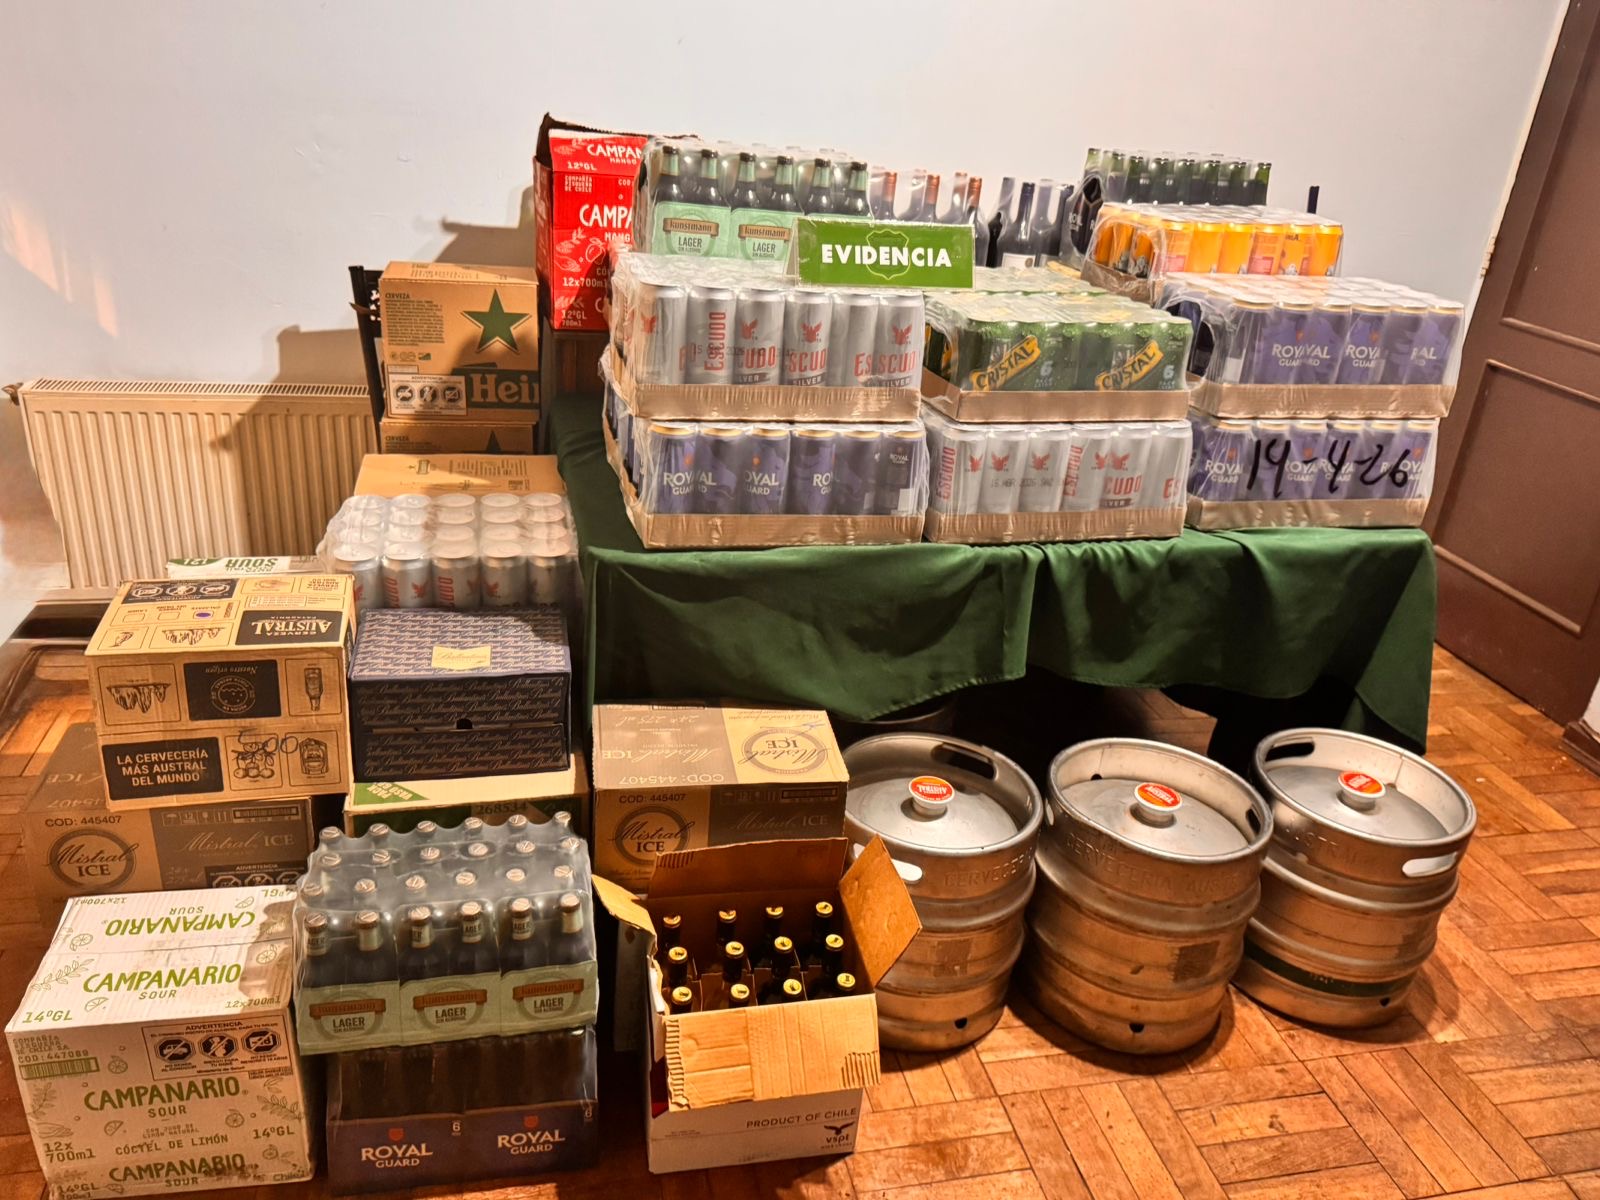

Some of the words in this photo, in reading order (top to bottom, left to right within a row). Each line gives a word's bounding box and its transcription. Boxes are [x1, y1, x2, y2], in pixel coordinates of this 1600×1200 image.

[678, 236, 703, 248] LAGER
[752, 242, 777, 254] LAGER
[821, 244, 953, 269] EVIDENCIA
[975, 344, 1035, 390] CRISTAL
[1040, 361, 1053, 376] 6
[1101, 351, 1156, 390] CRISTAL
[1163, 364, 1175, 380] 6
[225, 557, 279, 568] SOUR
[250, 618, 332, 636] AUSTRAL
[765, 739, 798, 748] ICE
[116, 755, 133, 766] LA
[135, 749, 209, 765] CERVECERÍA
[602, 750, 632, 760] ICE
[737, 748, 828, 765] Mistral
[122, 763, 149, 777] MÁS
[151, 760, 207, 774] AUSTRAL
[131, 775, 155, 787] DEL
[156, 773, 200, 786] MUNDO
[619, 774, 678, 786] 445407
[682, 773, 725, 784] COD:
[618, 794, 648, 804] COD:
[45, 817, 78, 828] COD:
[80, 815, 122, 825] 445407
[802, 814, 829, 826] ICE
[608, 821, 696, 842] Mistral
[264, 834, 296, 848] ICE
[636, 841, 665, 853] ICE
[42, 843, 140, 868] Mistral
[77, 863, 112, 878] ICE
[169, 905, 205, 915] SOUR
[104, 911, 256, 937] CAMPANARIO
[82, 963, 242, 993] CAMPANARIO
[138, 989, 178, 1000] SOUR
[225, 994, 281, 1009] 12x700ml
[533, 996, 564, 1009] LAGER
[434, 1006, 467, 1019] LAGER
[185, 1021, 243, 1031] ADVERTENCIA
[332, 1016, 366, 1029] LAGER
[84, 1076, 241, 1112] CAMPANARIO
[147, 1104, 188, 1118] SOUR
[746, 1115, 802, 1129] PRODUCT
[805, 1113, 823, 1123] OF
[824, 1107, 857, 1119] CHILE
[452, 1122, 460, 1132] 6
[168, 1139, 184, 1150] DE
[191, 1133, 229, 1147] LIMÓN
[497, 1128, 566, 1149] ROYAL
[42, 1141, 73, 1152] 12x
[361, 1142, 433, 1161] ROYAL
[510, 1142, 553, 1155] GUARD
[46, 1147, 97, 1164] 700ml
[375, 1157, 420, 1168] GUARD
[108, 1152, 246, 1183] CAMPANARIO
[164, 1176, 200, 1188] SOUR
